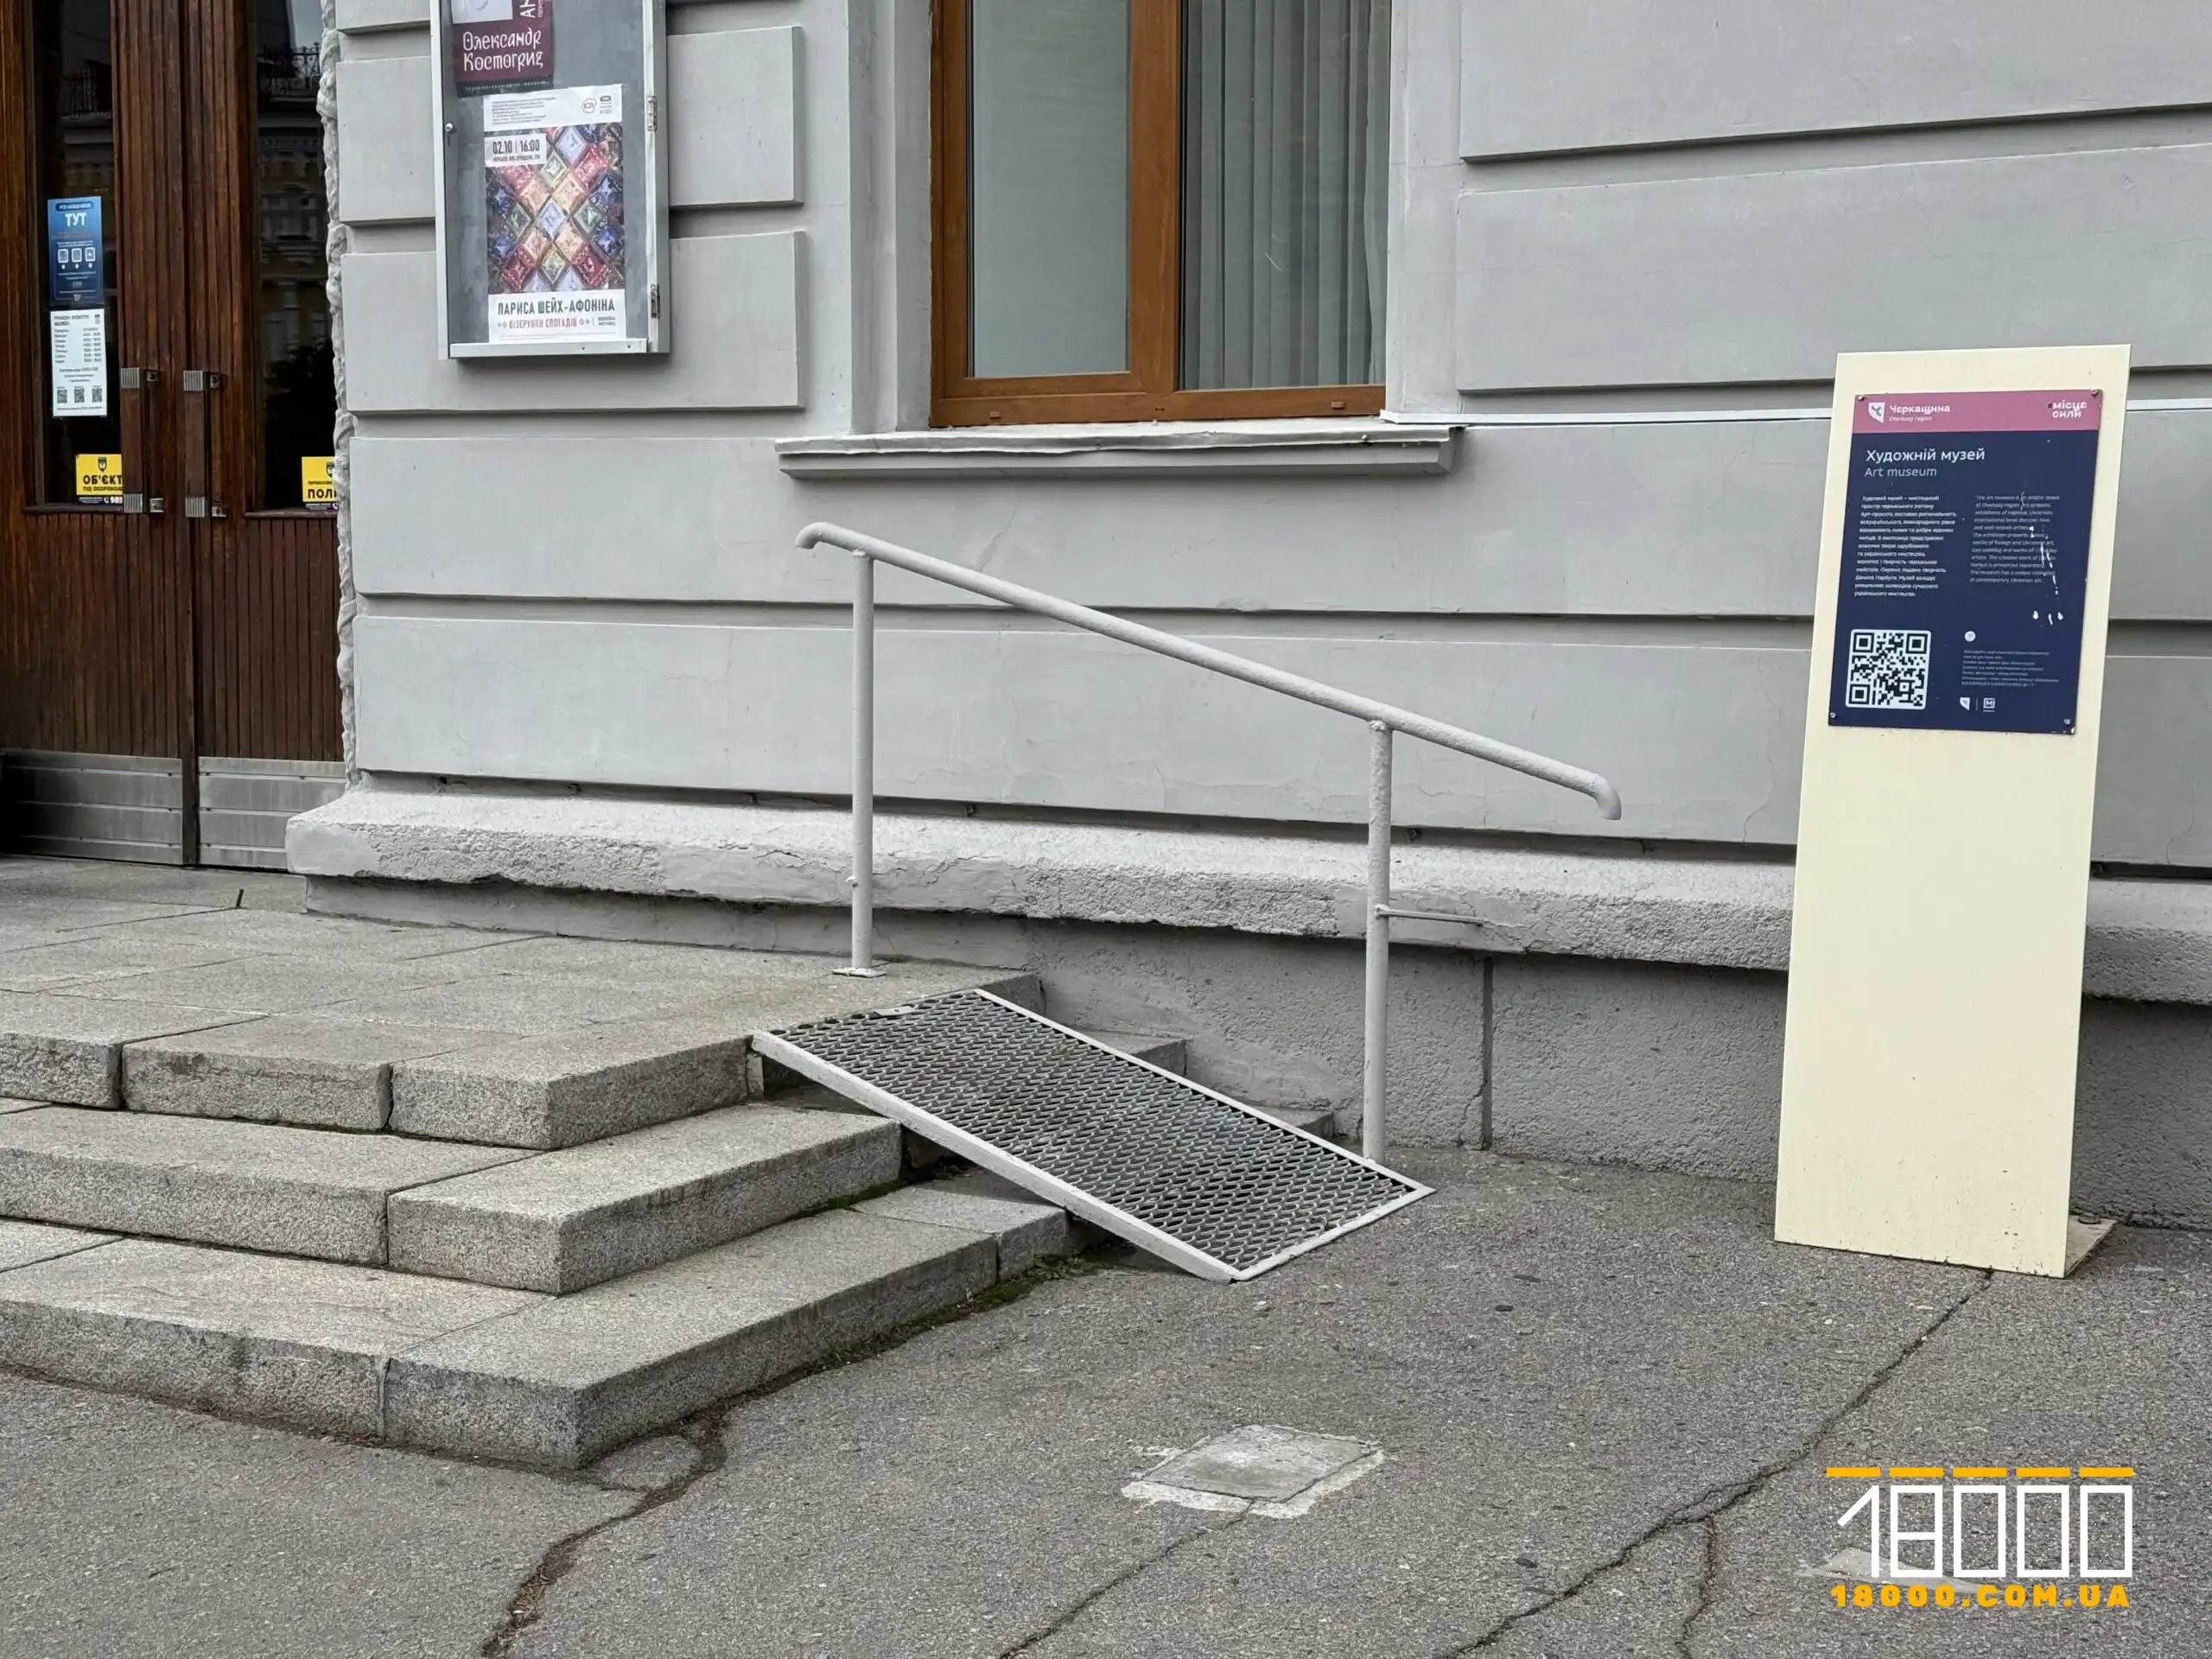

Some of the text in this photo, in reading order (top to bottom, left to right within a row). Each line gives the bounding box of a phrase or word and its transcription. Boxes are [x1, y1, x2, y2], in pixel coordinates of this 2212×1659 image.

[463, 28, 542, 51] Олександр
[463, 51, 543, 72] Костогриз
[493, 139, 540, 155] 02.10 16:00
[65, 213, 86, 227] ТУТ
[498, 297, 615, 315] ЛАРИСА ШЕЙХ-АФОНІНА
[1890, 404, 1951, 415] Черкащина
[1866, 448, 1986, 463] Художній музей
[1865, 467, 1937, 477] Art museum
